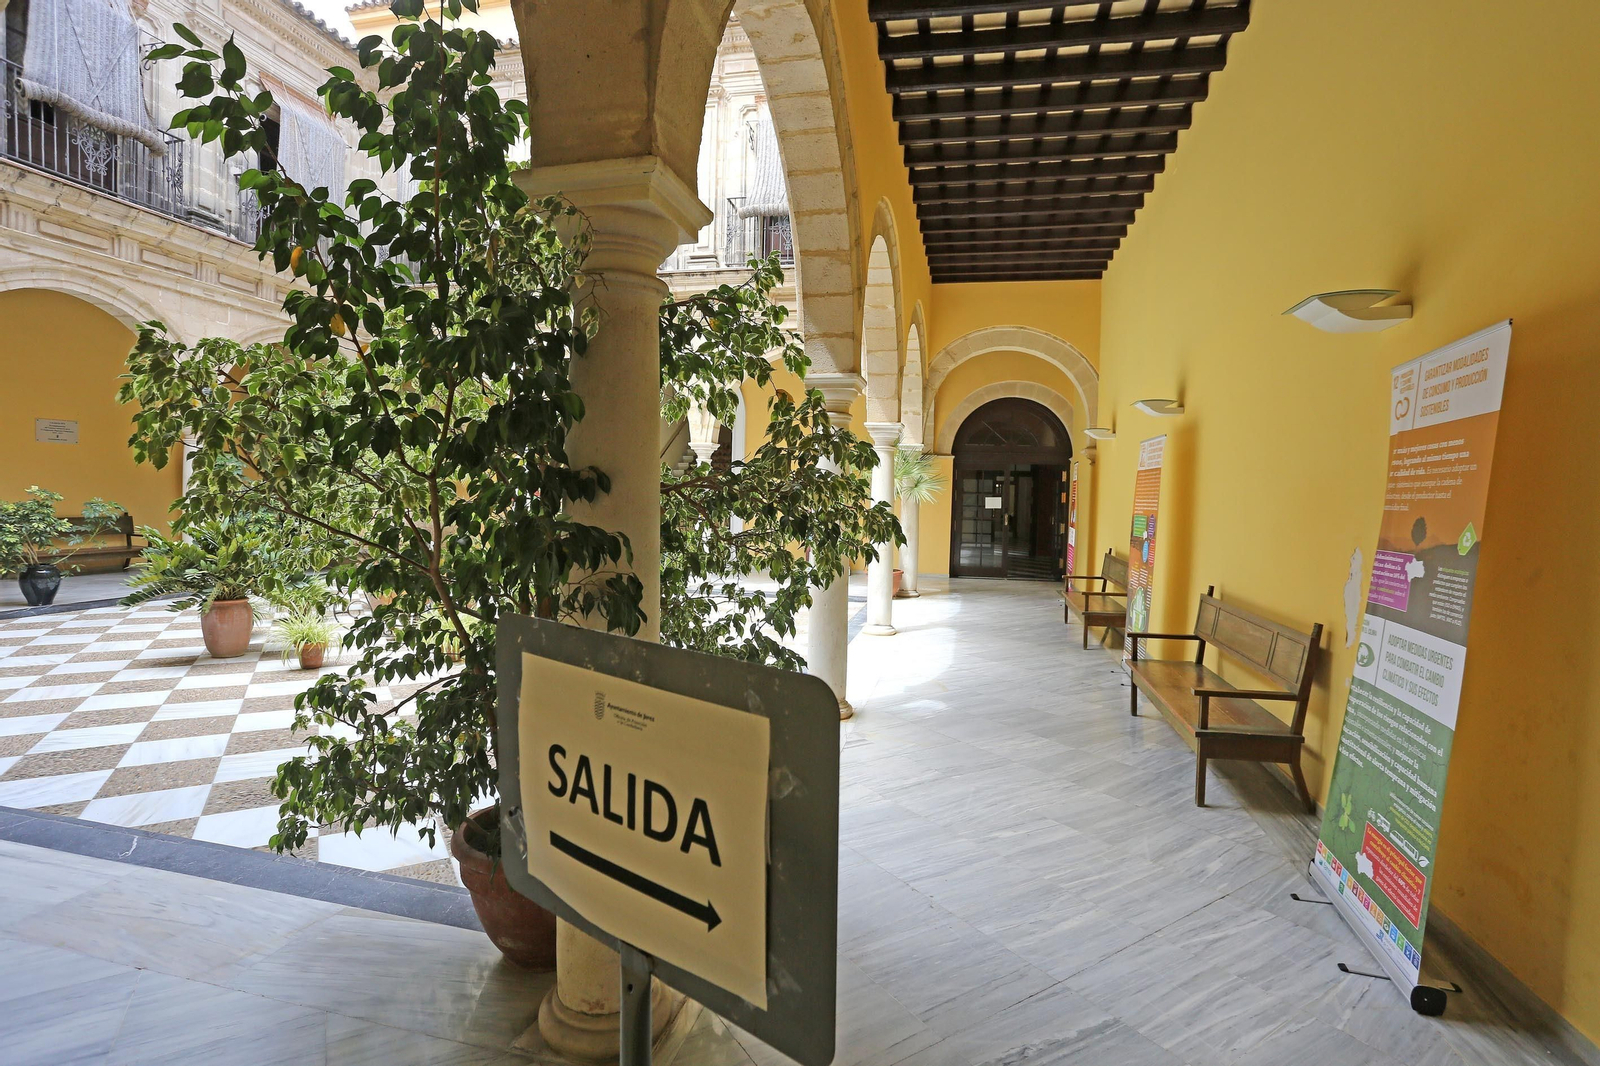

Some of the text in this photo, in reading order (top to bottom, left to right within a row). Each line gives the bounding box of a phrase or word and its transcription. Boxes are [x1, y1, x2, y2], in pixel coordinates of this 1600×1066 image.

[1422, 387, 1428, 399] DE
[1428, 379, 1450, 398] CONSUMO
[1450, 378, 1455, 391] Y
[1454, 364, 1488, 390] PRODUCCIÓN
[1424, 360, 1452, 381] GARANTIZAR
[1452, 346, 1489, 372] MODALIDADES
[1420, 398, 1449, 417] SOSTENIBLES
[1384, 650, 1445, 688] PARA COMBATIR EL CAMBIO
[1387, 633, 1454, 671] ADOPTAR MEDIDAS URGENTES
[1381, 666, 1439, 707] CLIMÁTICO Y SUS EFECTOS
[606, 701, 655, 723] Ayuntamiento de Jerez
[1401, 710, 1425, 733] capacidad
[1424, 723, 1431, 735] de
[1382, 712, 1399, 730] riesgos
[1398, 722, 1428, 747] relacionados
[1427, 742, 1437, 753] con
[1437, 746, 1443, 757] el
[1394, 746, 1413, 767] mejorar
[1413, 758, 1419, 769] la
[1383, 766, 1406, 790] temprana
[1405, 783, 1410, 793] y
[1408, 784, 1437, 815] mitigación
[1393, 759, 1417, 784] capacidad
[1416, 775, 1437, 798] humana
[548, 743, 722, 867] SALIDA
